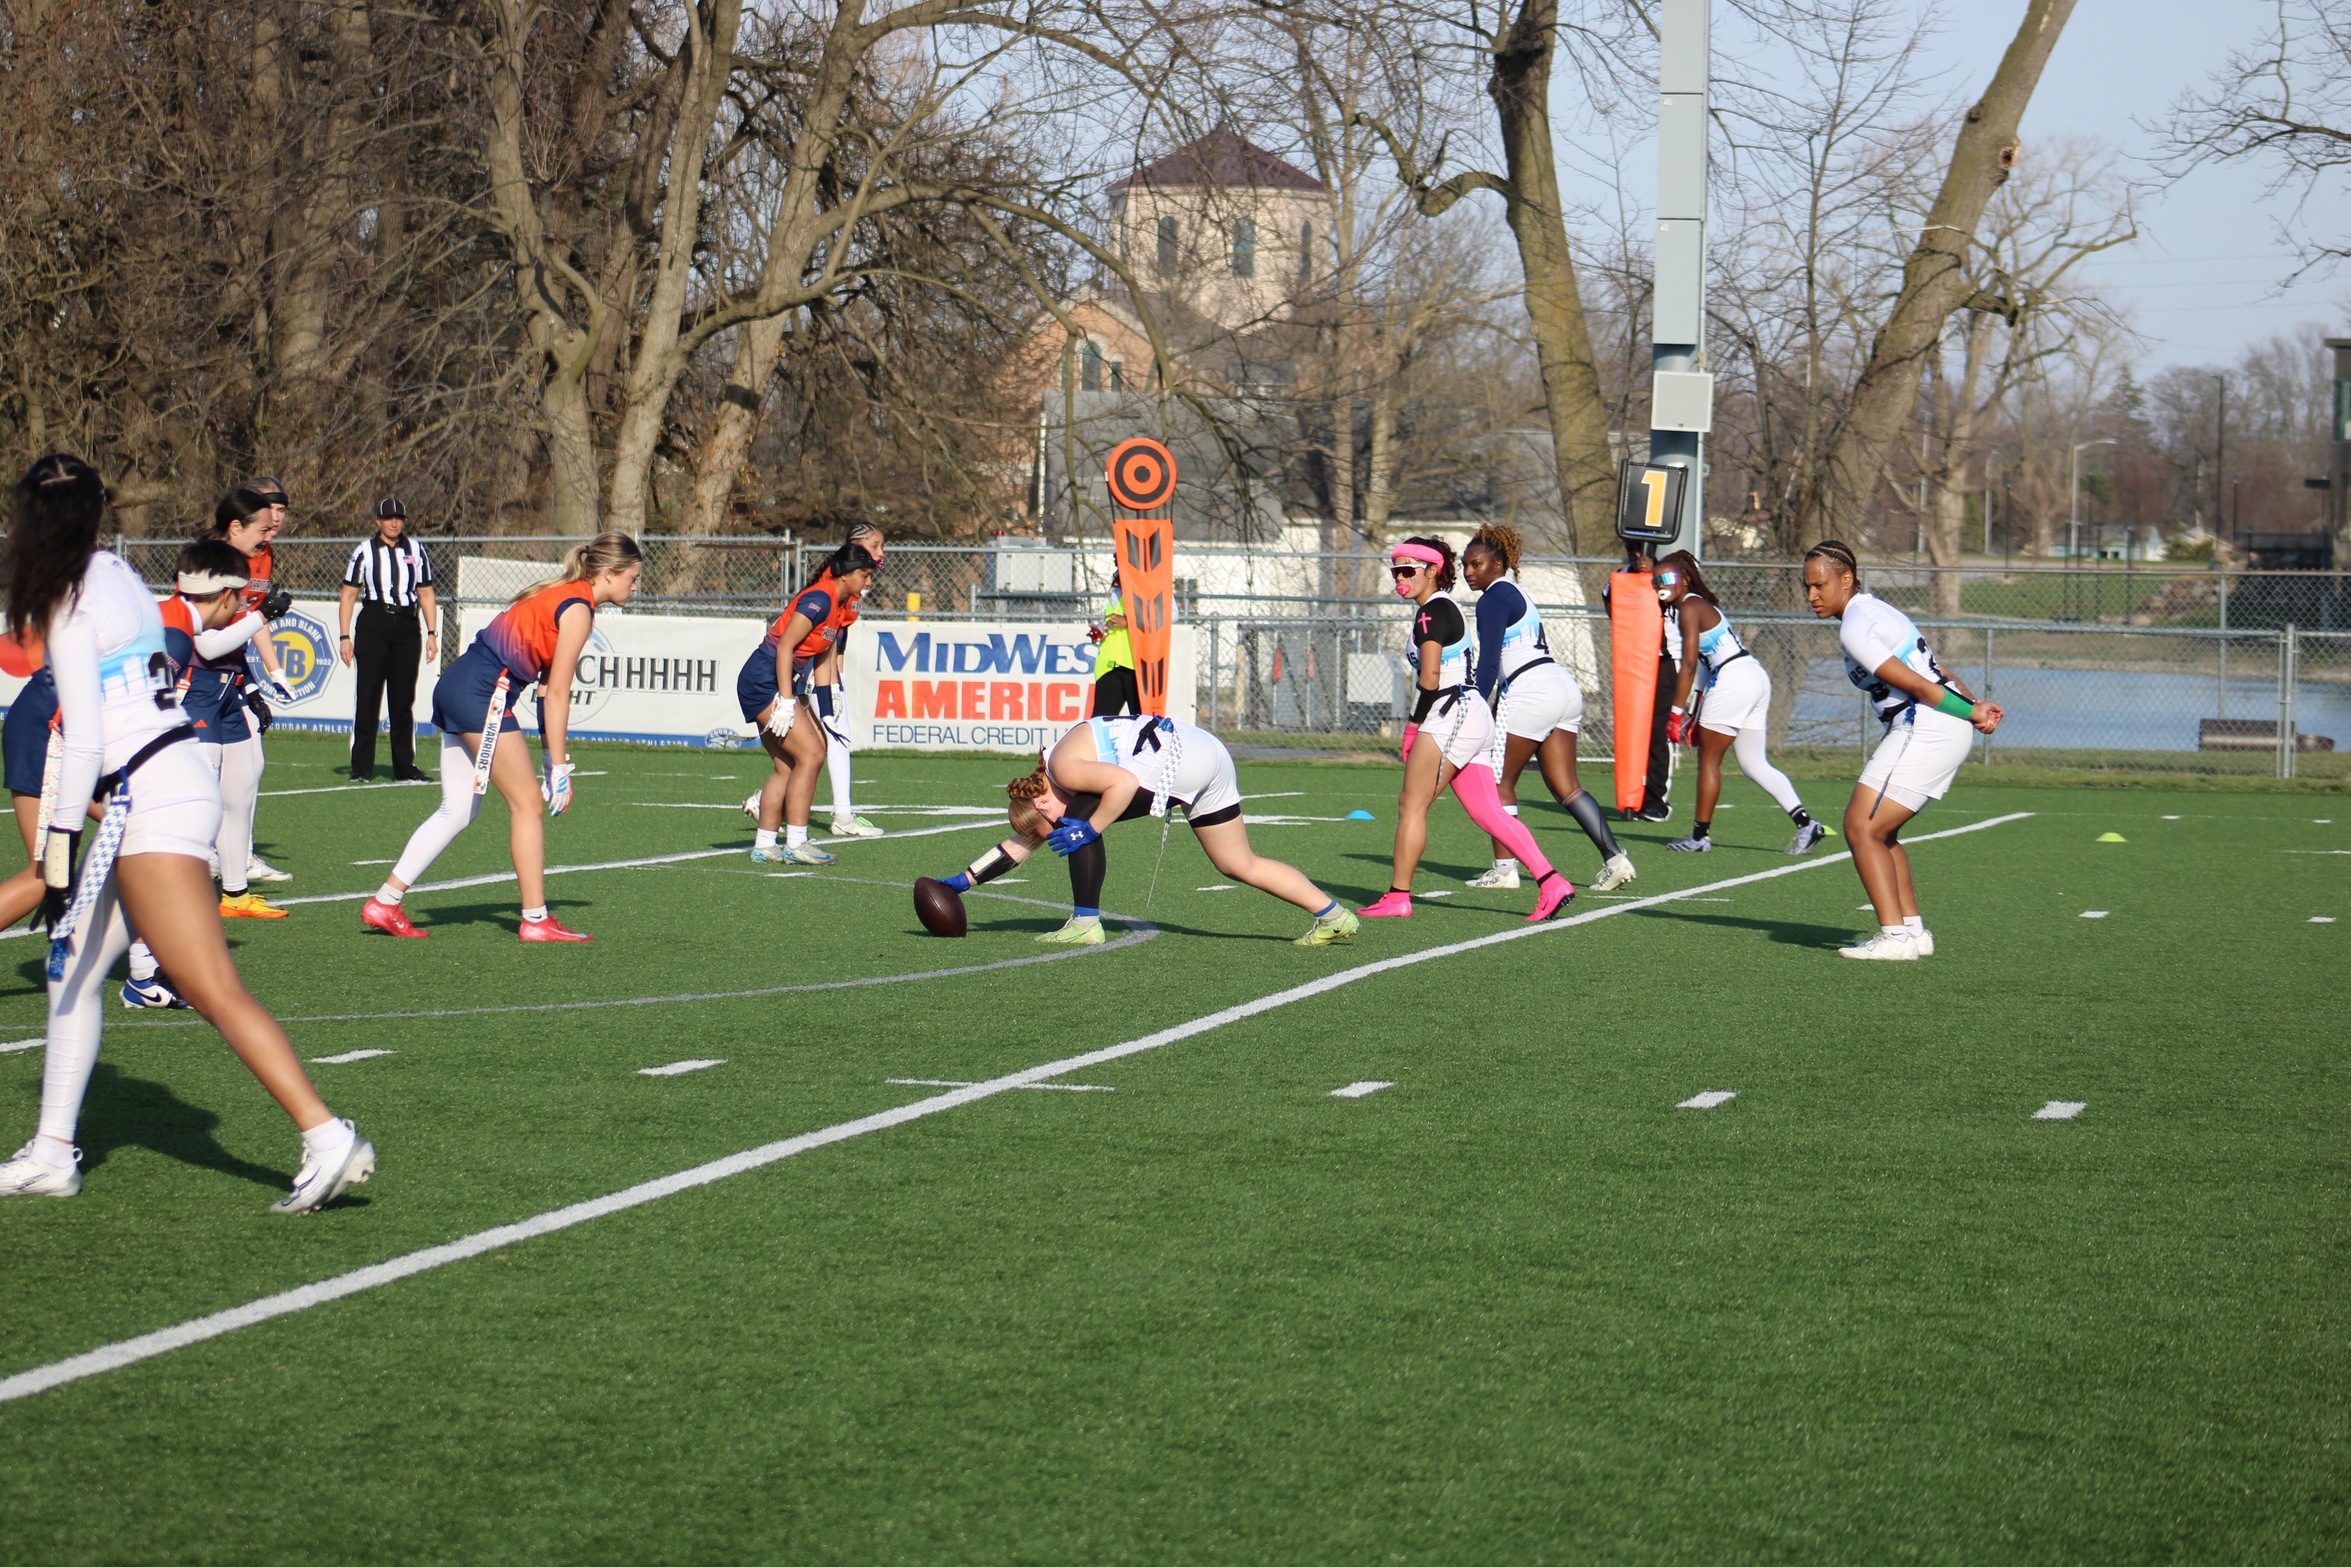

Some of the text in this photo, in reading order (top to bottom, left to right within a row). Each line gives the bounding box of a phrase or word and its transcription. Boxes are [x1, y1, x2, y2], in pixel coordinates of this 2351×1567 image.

[1641, 470, 1668, 527] 1
[280, 618, 296, 628] AND
[298, 620, 323, 643] BLANK
[273, 640, 306, 678] TB
[316, 658, 332, 666] 1922
[876, 632, 1098, 675] MIDWES
[576, 655, 717, 692] CHHHHH
[269, 722, 353, 734] COUGAR ATHLETI
[873, 725, 968, 745] FEDERAL
[971, 726, 1049, 746] CREDIT
[478, 722, 498, 772] WARRIORS
